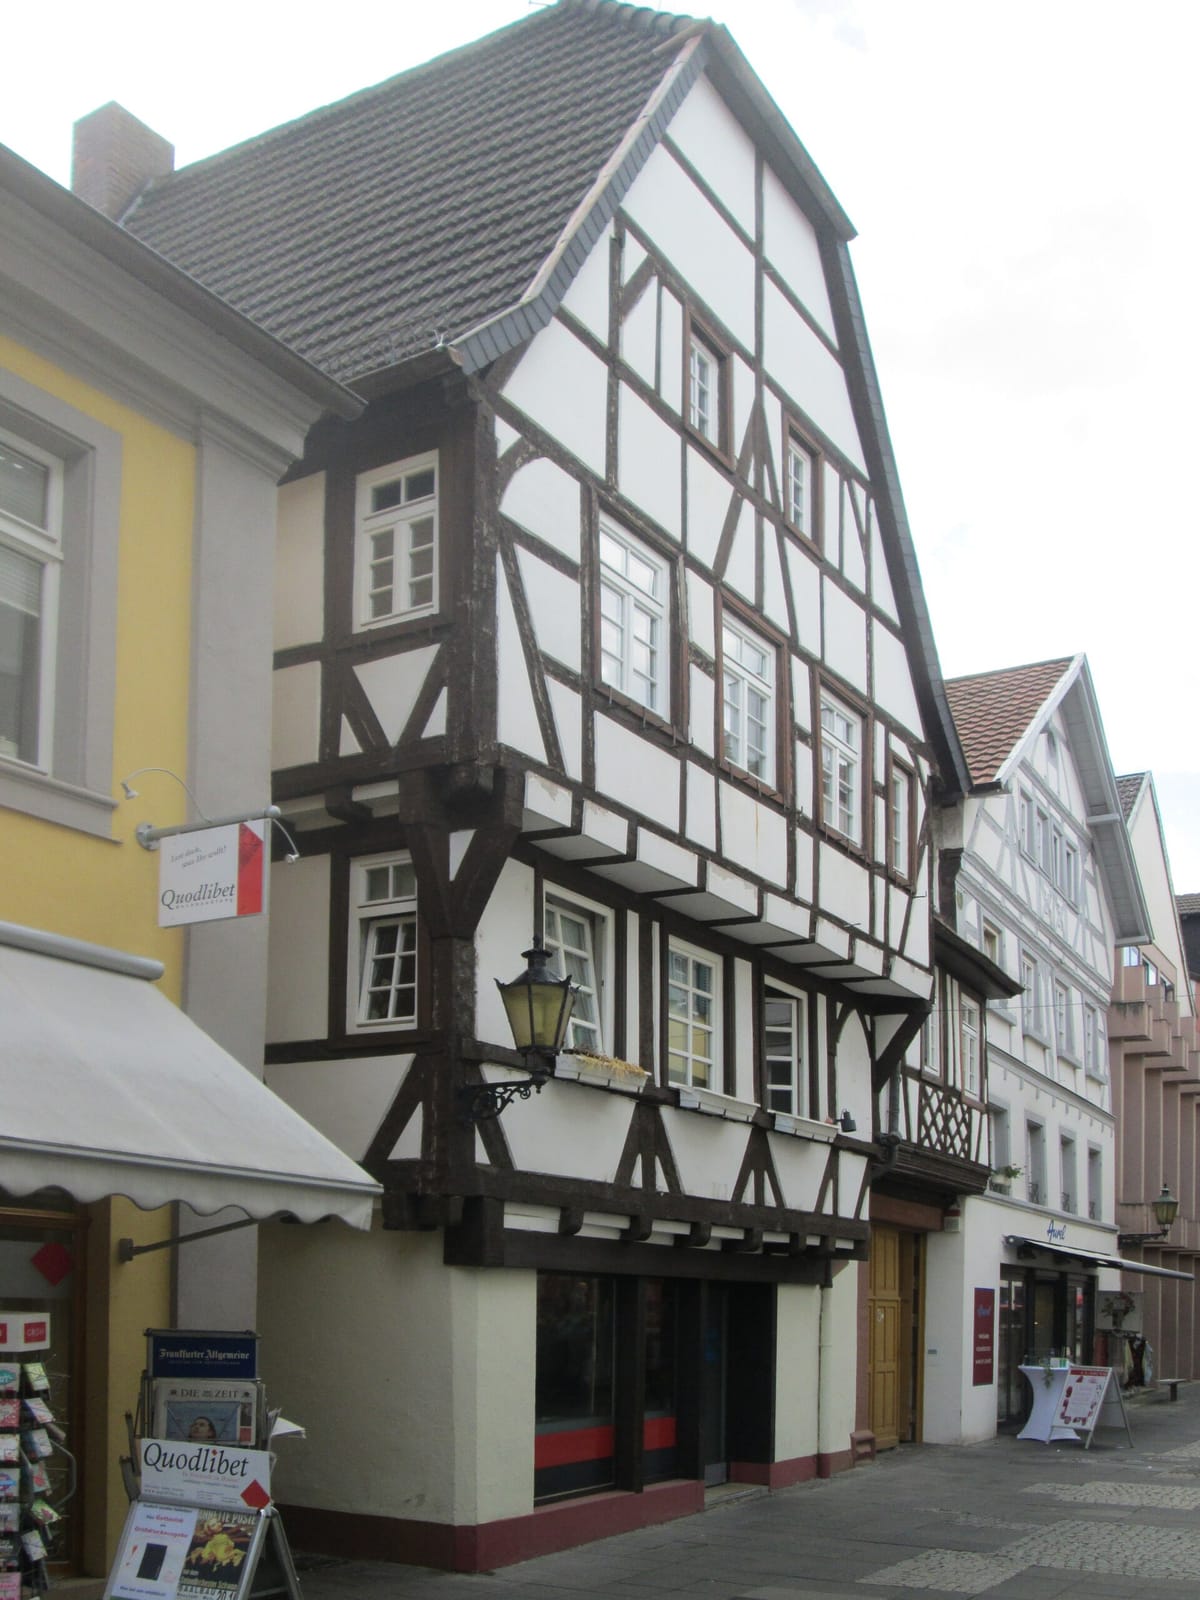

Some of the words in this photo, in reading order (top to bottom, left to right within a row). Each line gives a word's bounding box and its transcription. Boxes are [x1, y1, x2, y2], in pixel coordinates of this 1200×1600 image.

[161, 882, 235, 910] Quodlibet
[160, 1348, 204, 1360] Frankfurter
[204, 1349, 250, 1361] Allgemeine
[181, 1389, 199, 1398] DIE
[214, 1389, 239, 1399] ZEIT
[144, 1443, 249, 1477] Quodlibet
